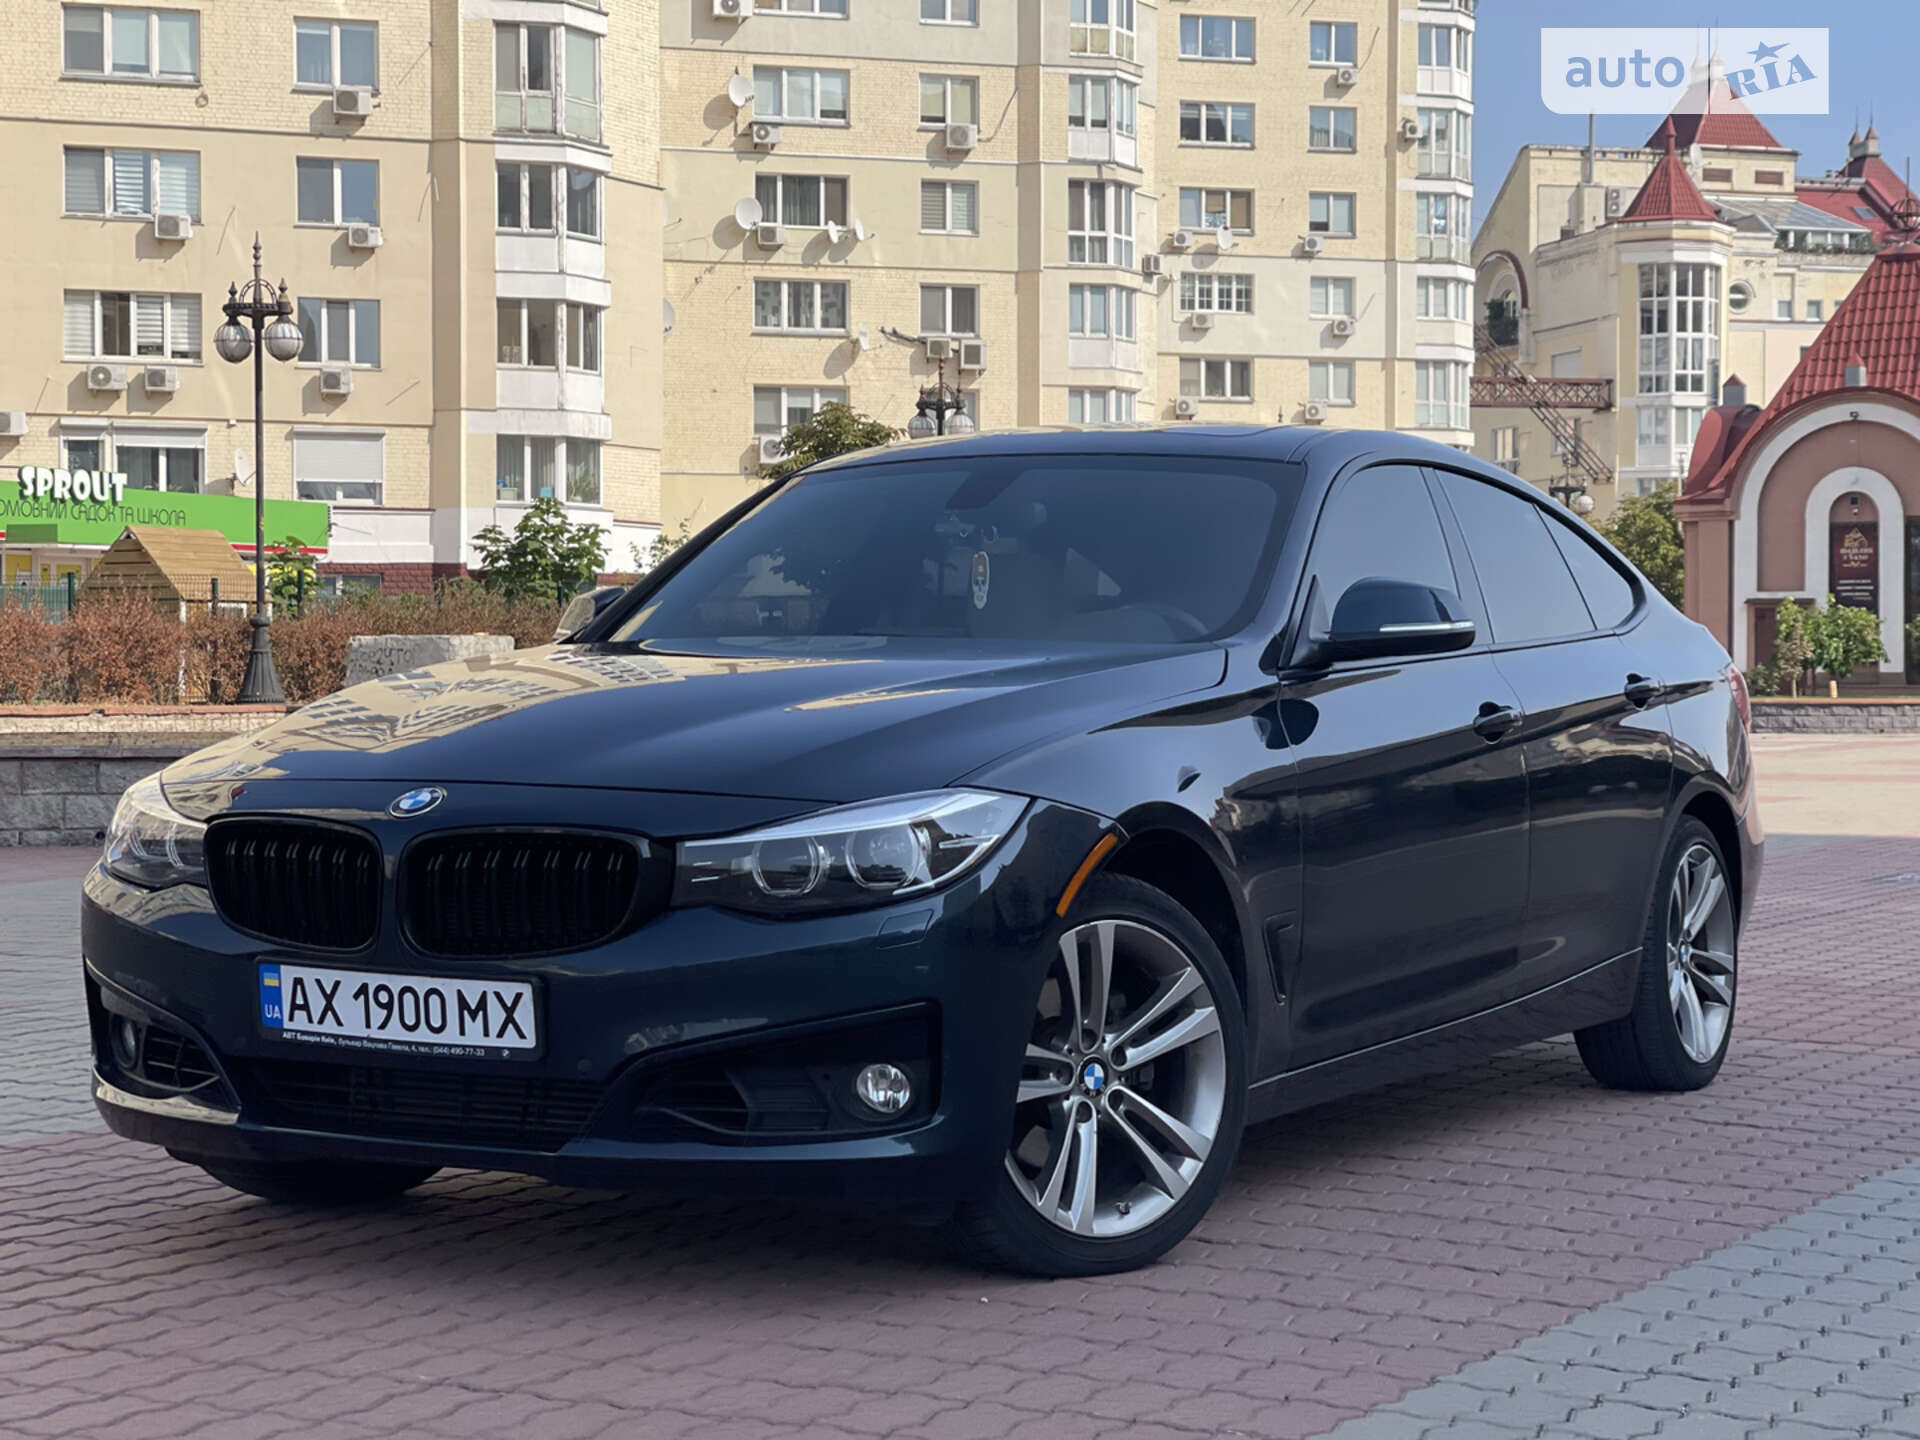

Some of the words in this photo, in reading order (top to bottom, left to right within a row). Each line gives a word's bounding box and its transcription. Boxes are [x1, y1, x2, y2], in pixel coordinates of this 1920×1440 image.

[20, 466, 127, 503] SPROUT
[71, 503, 116, 523] САДОК
[119, 506, 134, 523] ТА
[137, 508, 186, 525] ШКОЛА
[264, 1004, 281, 1020] UA
[288, 977, 344, 1027] AX
[352, 982, 447, 1034] 1900
[456, 988, 527, 1040] MX
